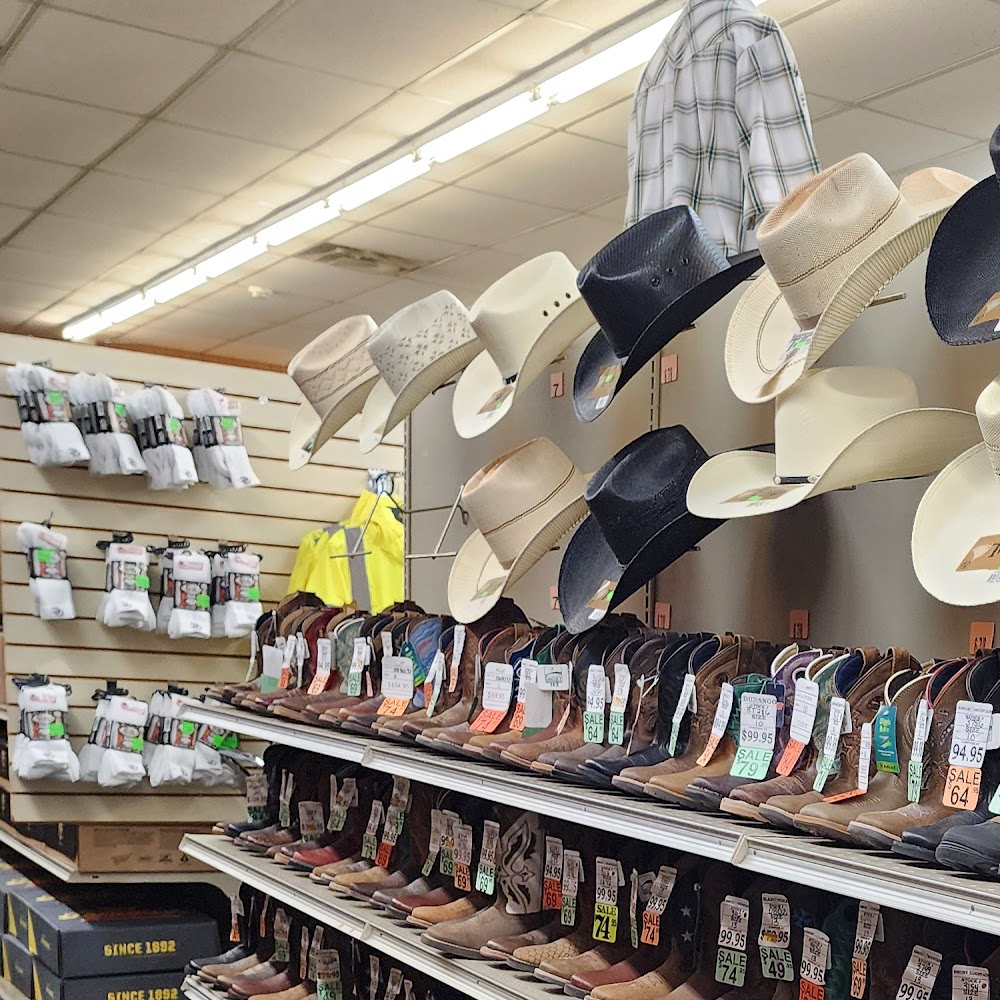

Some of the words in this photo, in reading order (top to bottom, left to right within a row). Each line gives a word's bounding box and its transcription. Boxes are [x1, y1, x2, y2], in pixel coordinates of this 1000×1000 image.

[385, 699, 408, 707] SALE
[480, 711, 502, 721] SALE
[584, 715, 604, 724] SALE
[742, 731, 773, 744] $99.95
[738, 749, 771, 762] SALE
[952, 744, 983, 762] 94.95
[950, 768, 980, 786] SALE
[479, 865, 494, 877] SALE
[544, 880, 561, 892] SALE
[596, 887, 616, 902] 99.95
[597, 905, 616, 916] SALE
[643, 912, 659, 926] SALE
[720, 930, 746, 948] 99.95
[103, 943, 143, 957] SINCE
[145, 940, 177, 954] 1892
[760, 948, 792, 962] SALE
[718, 951, 747, 966] SALE
[801, 961, 823, 982] 99.95
[800, 982, 824, 999] SALE
